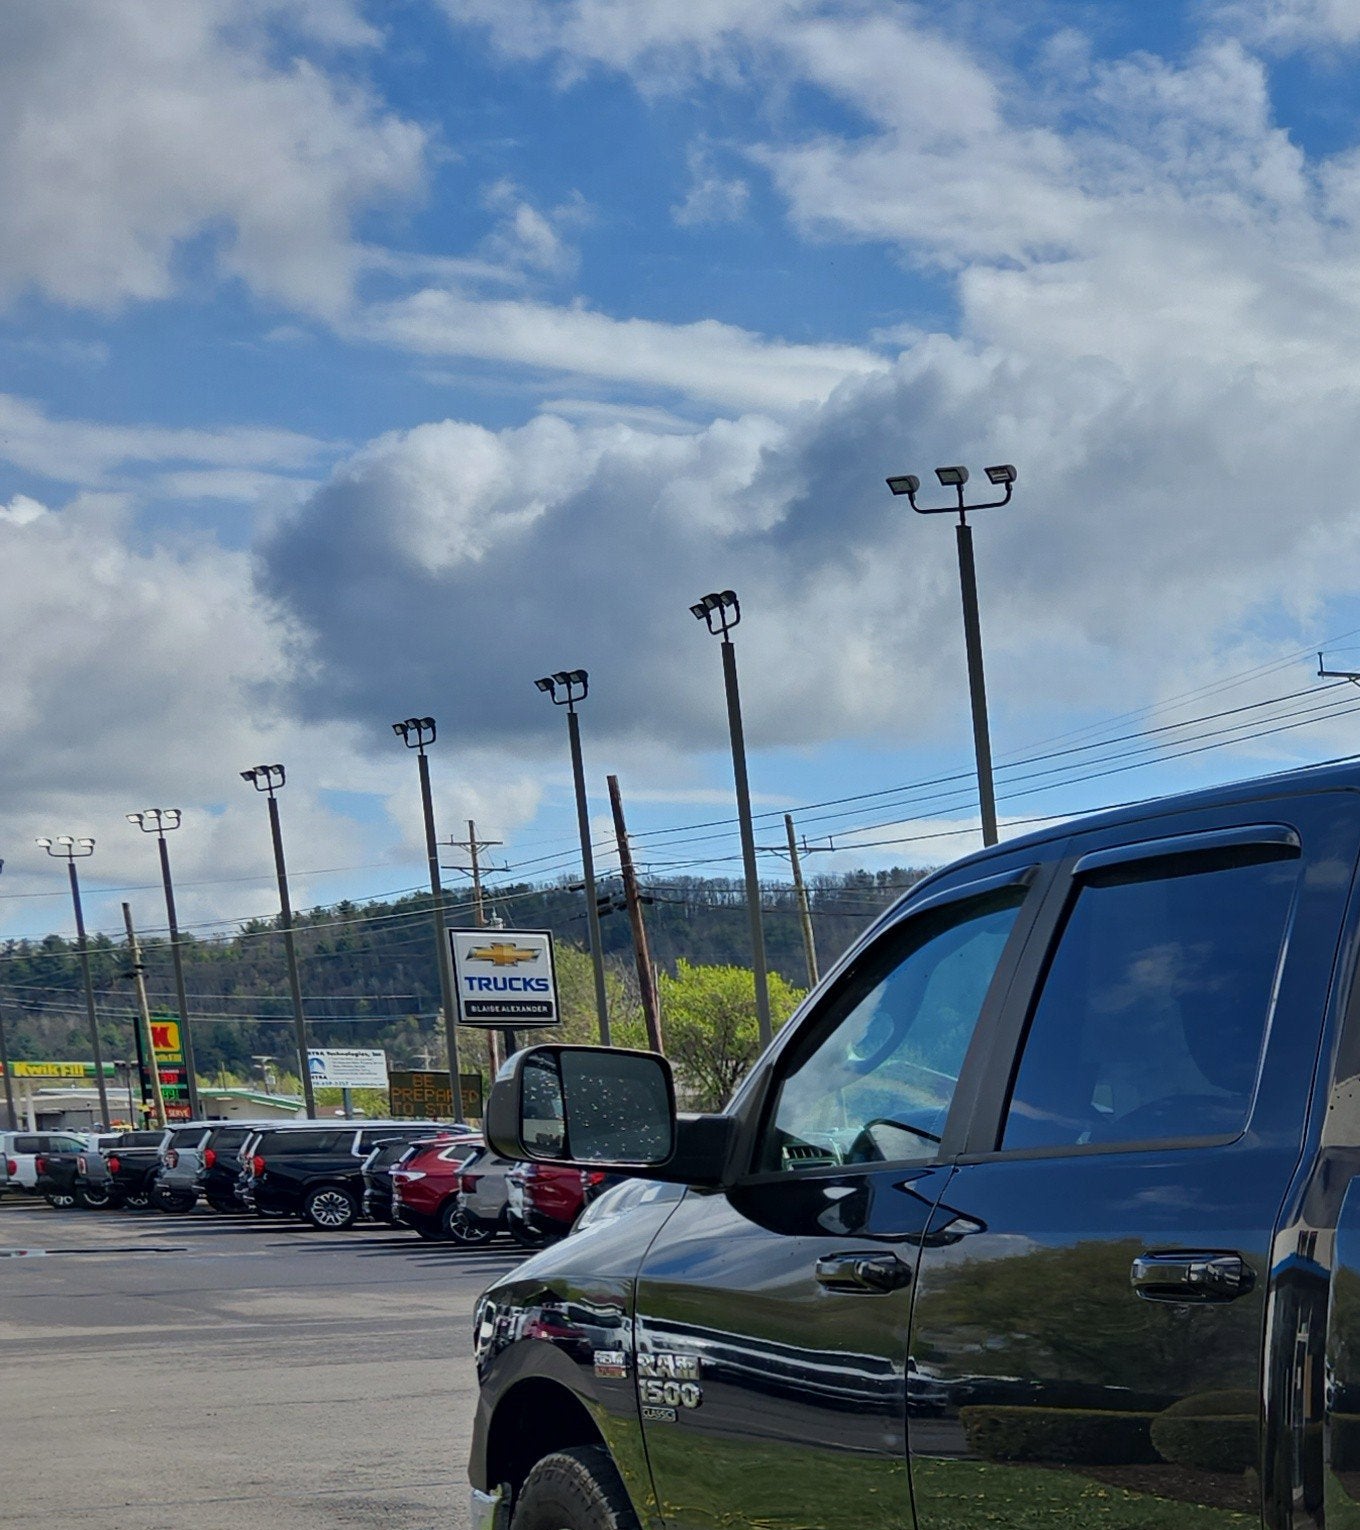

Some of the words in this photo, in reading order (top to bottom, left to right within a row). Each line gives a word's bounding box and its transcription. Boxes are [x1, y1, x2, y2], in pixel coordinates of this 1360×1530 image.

[464, 976, 549, 992] TRUCKS
[470, 1005, 501, 1013] BLAISE
[501, 1005, 548, 1013] ALEXANDER
[14, 1062, 60, 1077] Kwik
[60, 1062, 84, 1077] Fill
[413, 1074, 435, 1088] BE
[393, 1101, 414, 1116] TO
[637, 1352, 700, 1381] RAM
[638, 1378, 702, 1409] 1500
